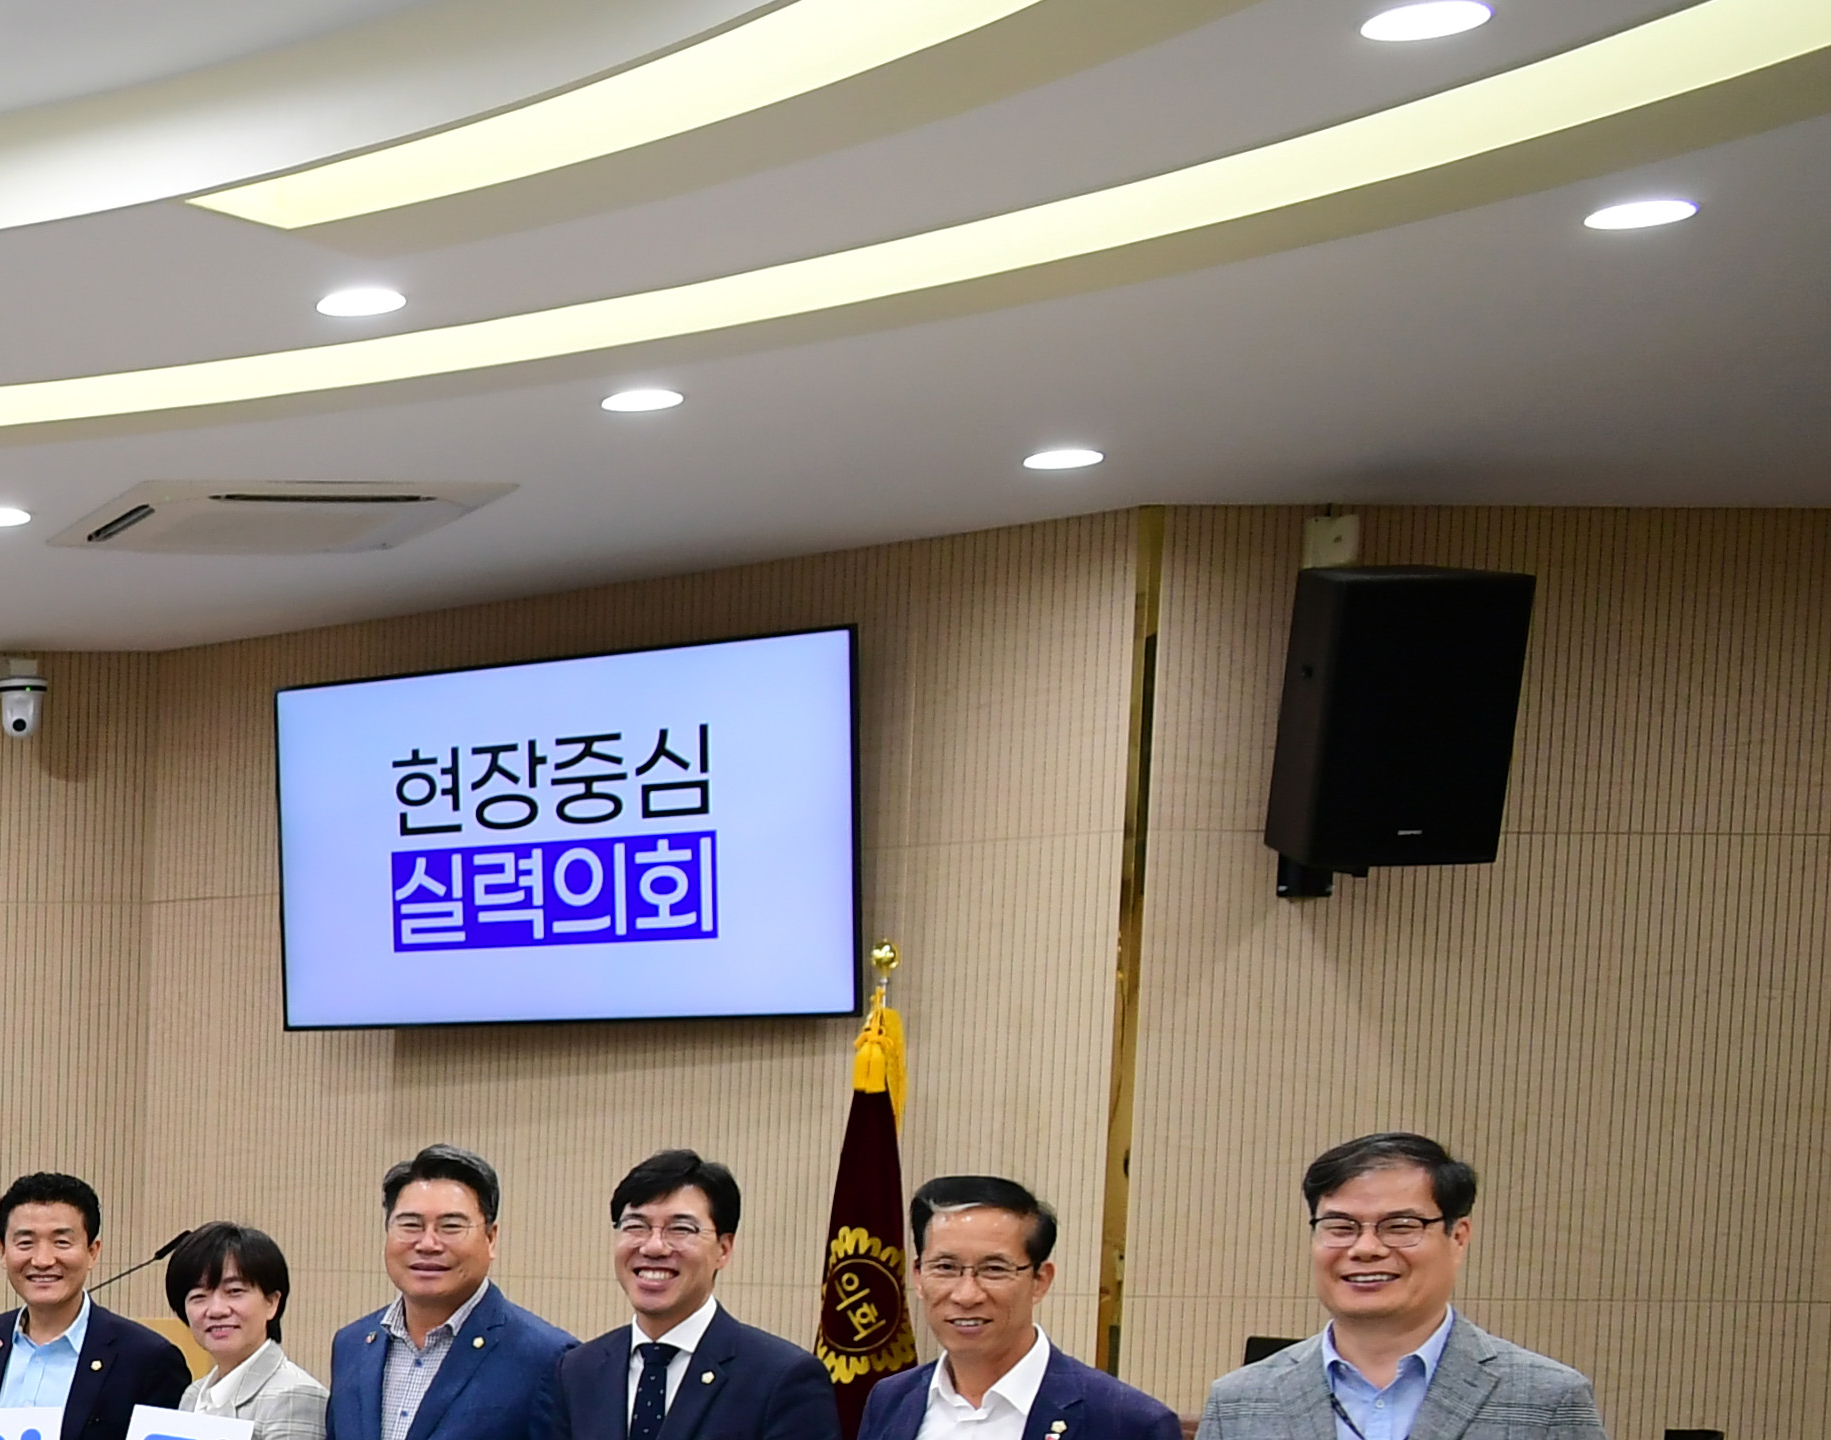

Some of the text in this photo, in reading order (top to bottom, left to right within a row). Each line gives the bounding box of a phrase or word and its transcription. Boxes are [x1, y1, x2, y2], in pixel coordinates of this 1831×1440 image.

[391, 723, 711, 837] 현장중심
[394, 836, 715, 946] 실력의회
[835, 1271, 887, 1341] 의회
